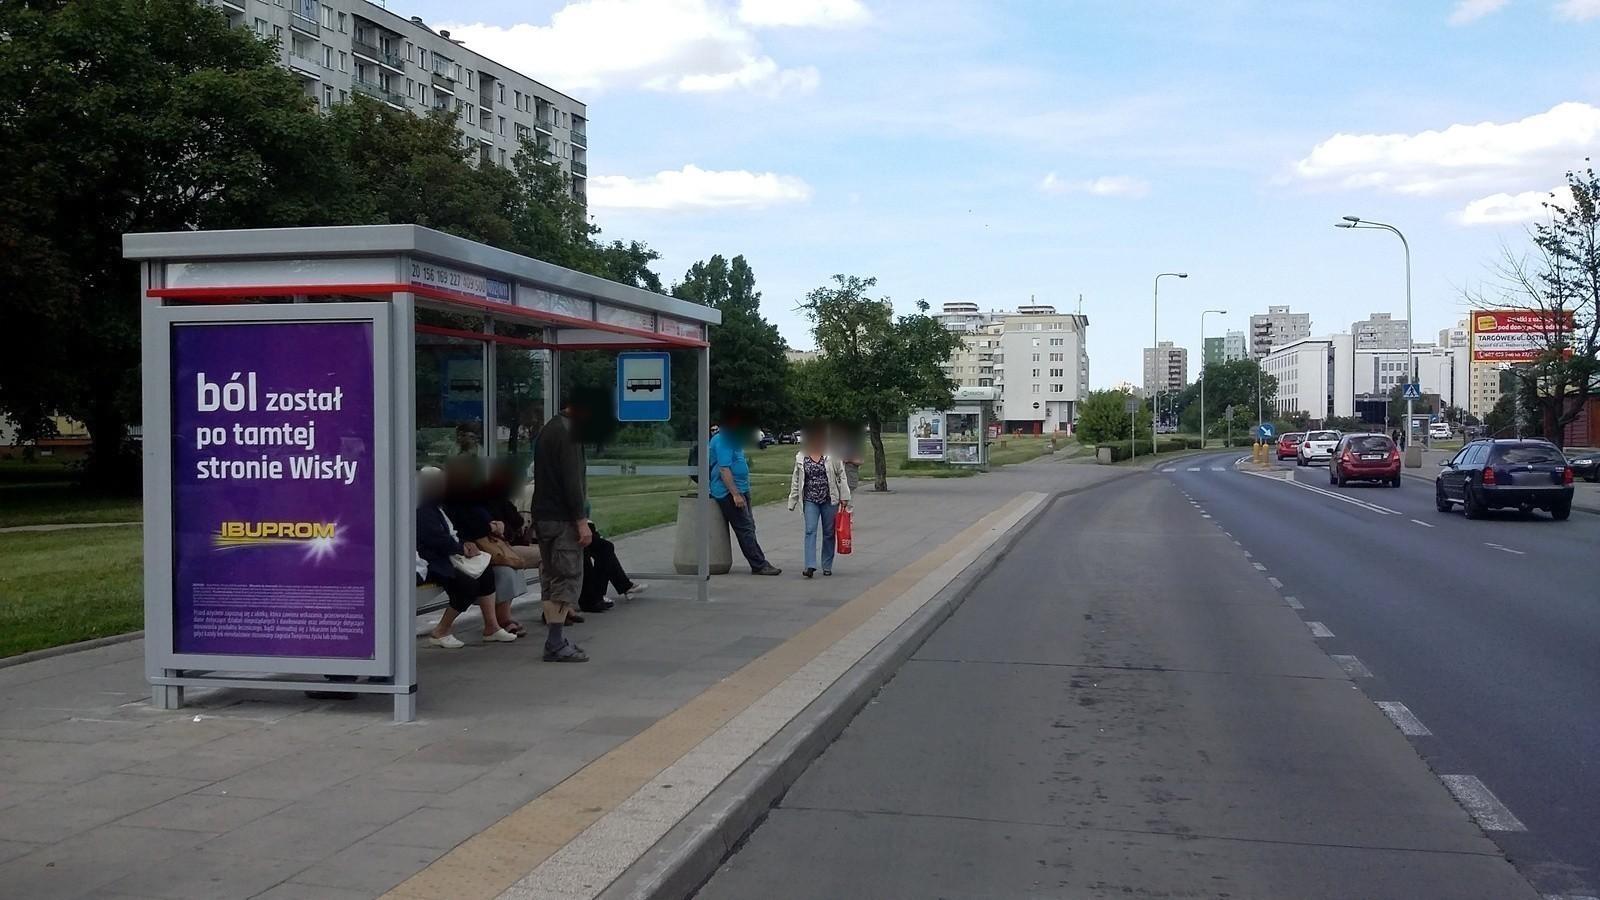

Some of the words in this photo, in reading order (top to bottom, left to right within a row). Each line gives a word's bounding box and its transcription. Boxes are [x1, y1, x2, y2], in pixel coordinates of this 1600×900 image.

[412, 264, 420, 278] 20
[423, 267, 435, 281] 156
[449, 273, 461, 286] 227
[197, 372, 257, 411] ból
[266, 386, 343, 411] został
[196, 427, 227, 450] po
[233, 420, 315, 450] tamtej
[196, 455, 283, 479] stronie
[289, 454, 358, 484] Wisły
[221, 522, 336, 539] IBUPROM
